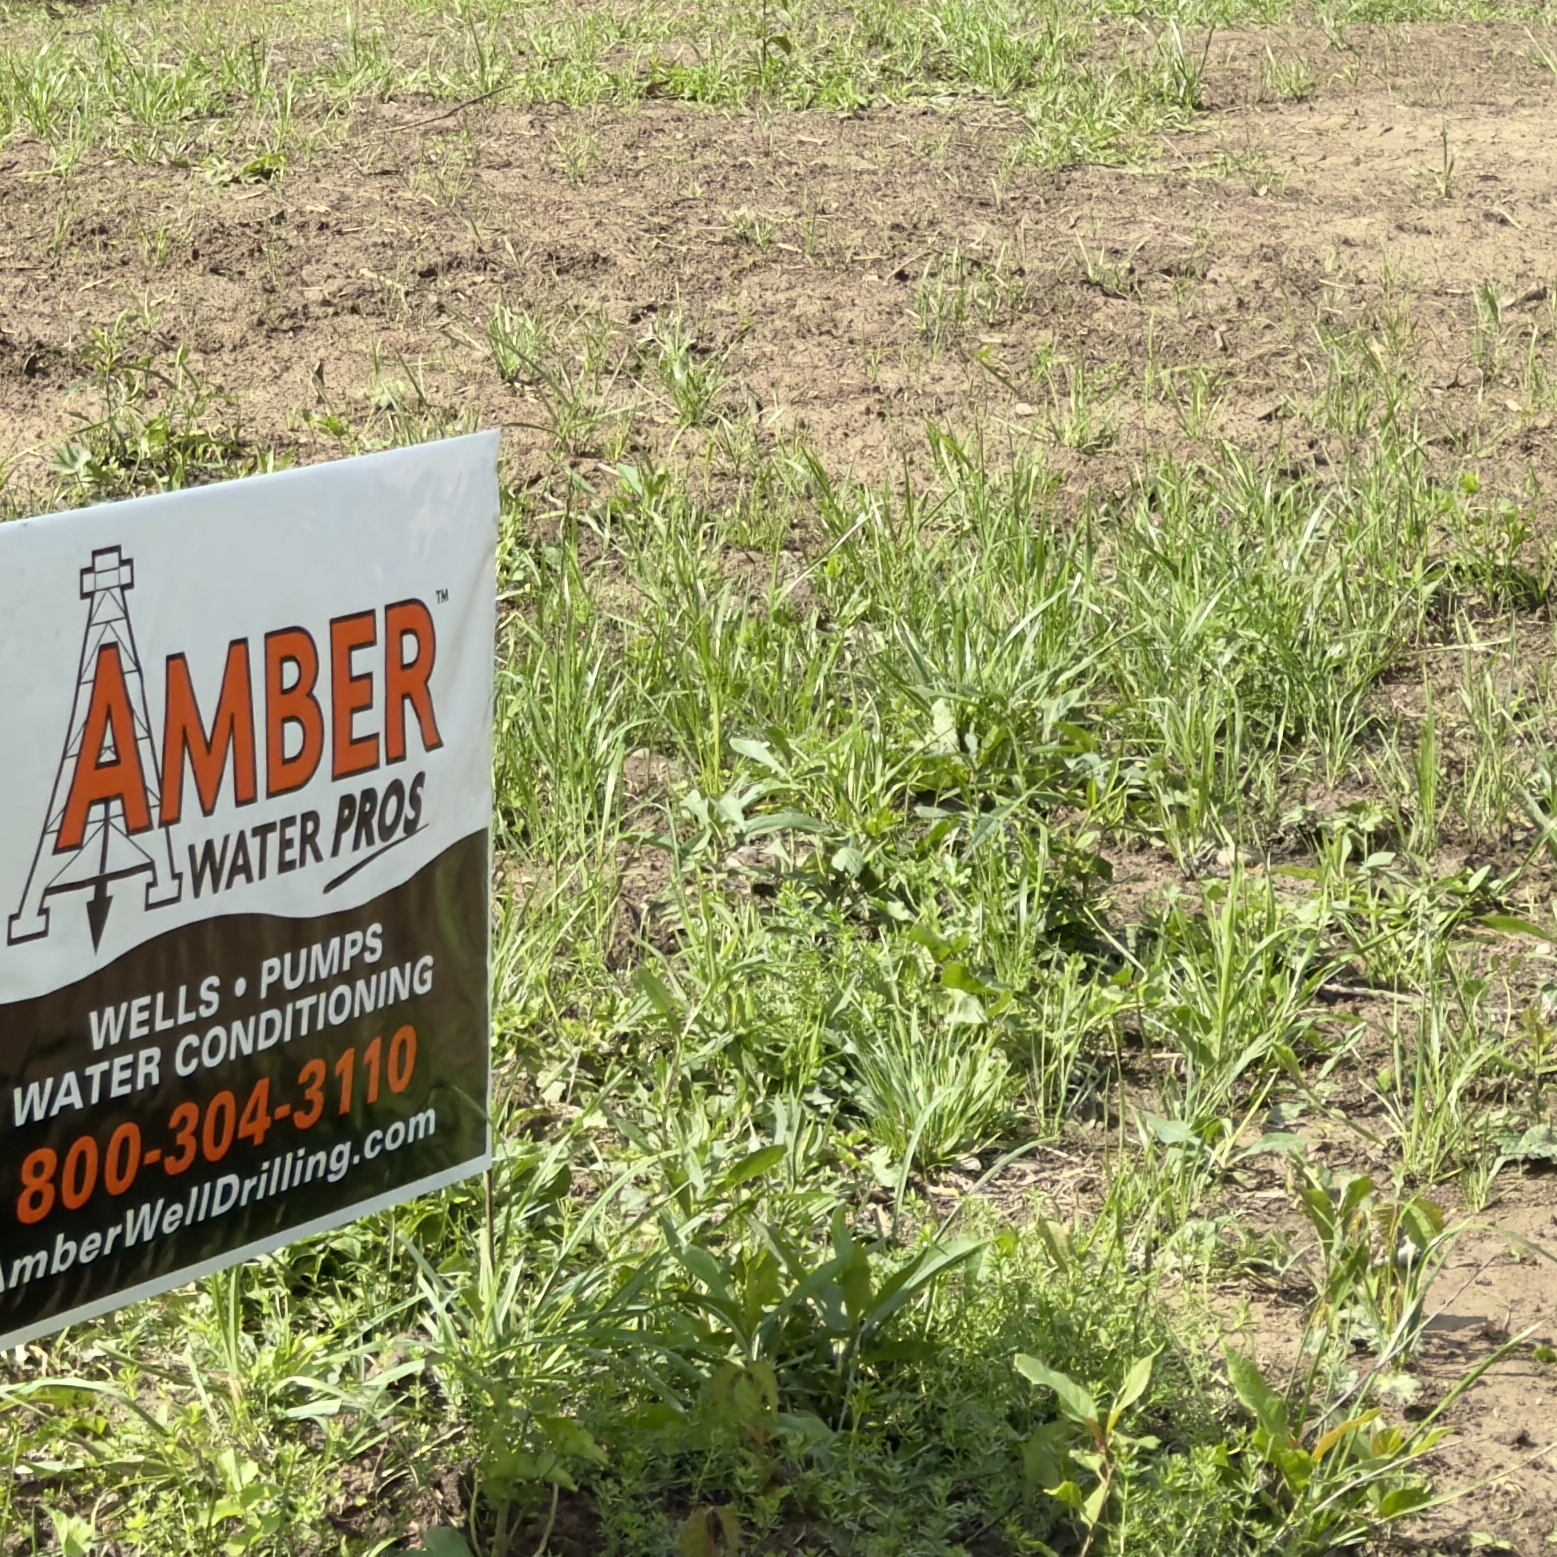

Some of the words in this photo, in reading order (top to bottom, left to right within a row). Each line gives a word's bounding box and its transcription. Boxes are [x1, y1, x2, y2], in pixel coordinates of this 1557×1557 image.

[53, 596, 444, 857] AMBER
[189, 808, 321, 899] WATER
[330, 770, 427, 864] PROS
[12, 1046, 161, 1128] WATER
[174, 956, 436, 1077] CONDITIONING
[89, 973, 221, 1052] WELLS
[258, 921, 385, 999] PUMPS
[16, 1024, 418, 1226] 800-304-3110
